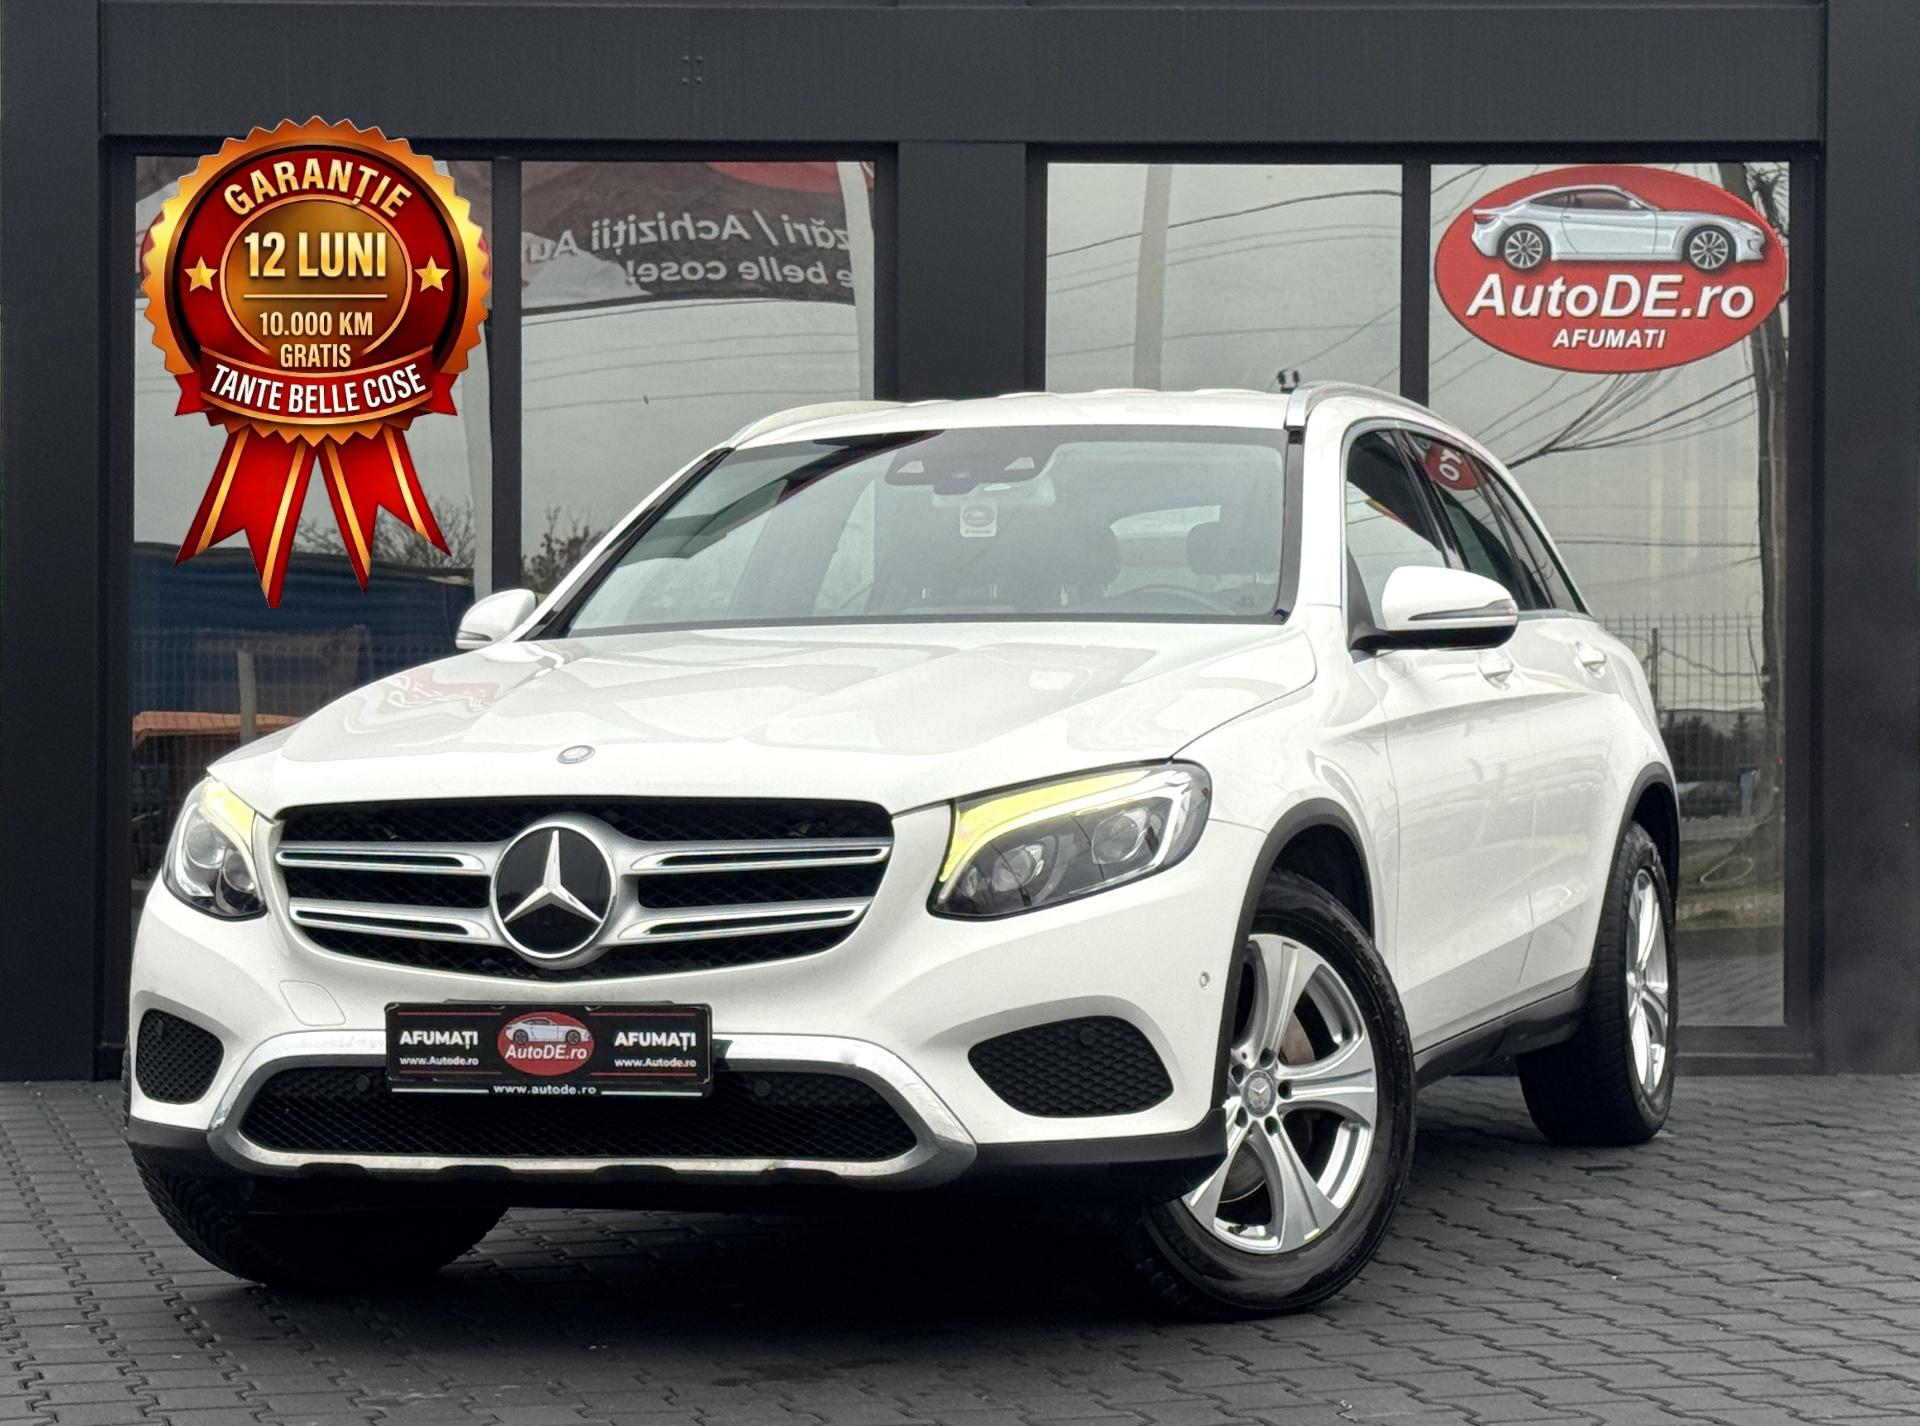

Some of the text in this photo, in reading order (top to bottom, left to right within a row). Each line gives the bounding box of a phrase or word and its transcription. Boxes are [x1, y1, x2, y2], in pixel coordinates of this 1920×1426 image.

[1465, 273, 1755, 319] AutoDE.ro
[1552, 329, 1667, 349] AFUMATI
[504, 1044, 588, 1061] AutoDE.ro
[399, 1056, 479, 1067] www.Autode.ro
[493, 1083, 597, 1096] www.autode.ro
